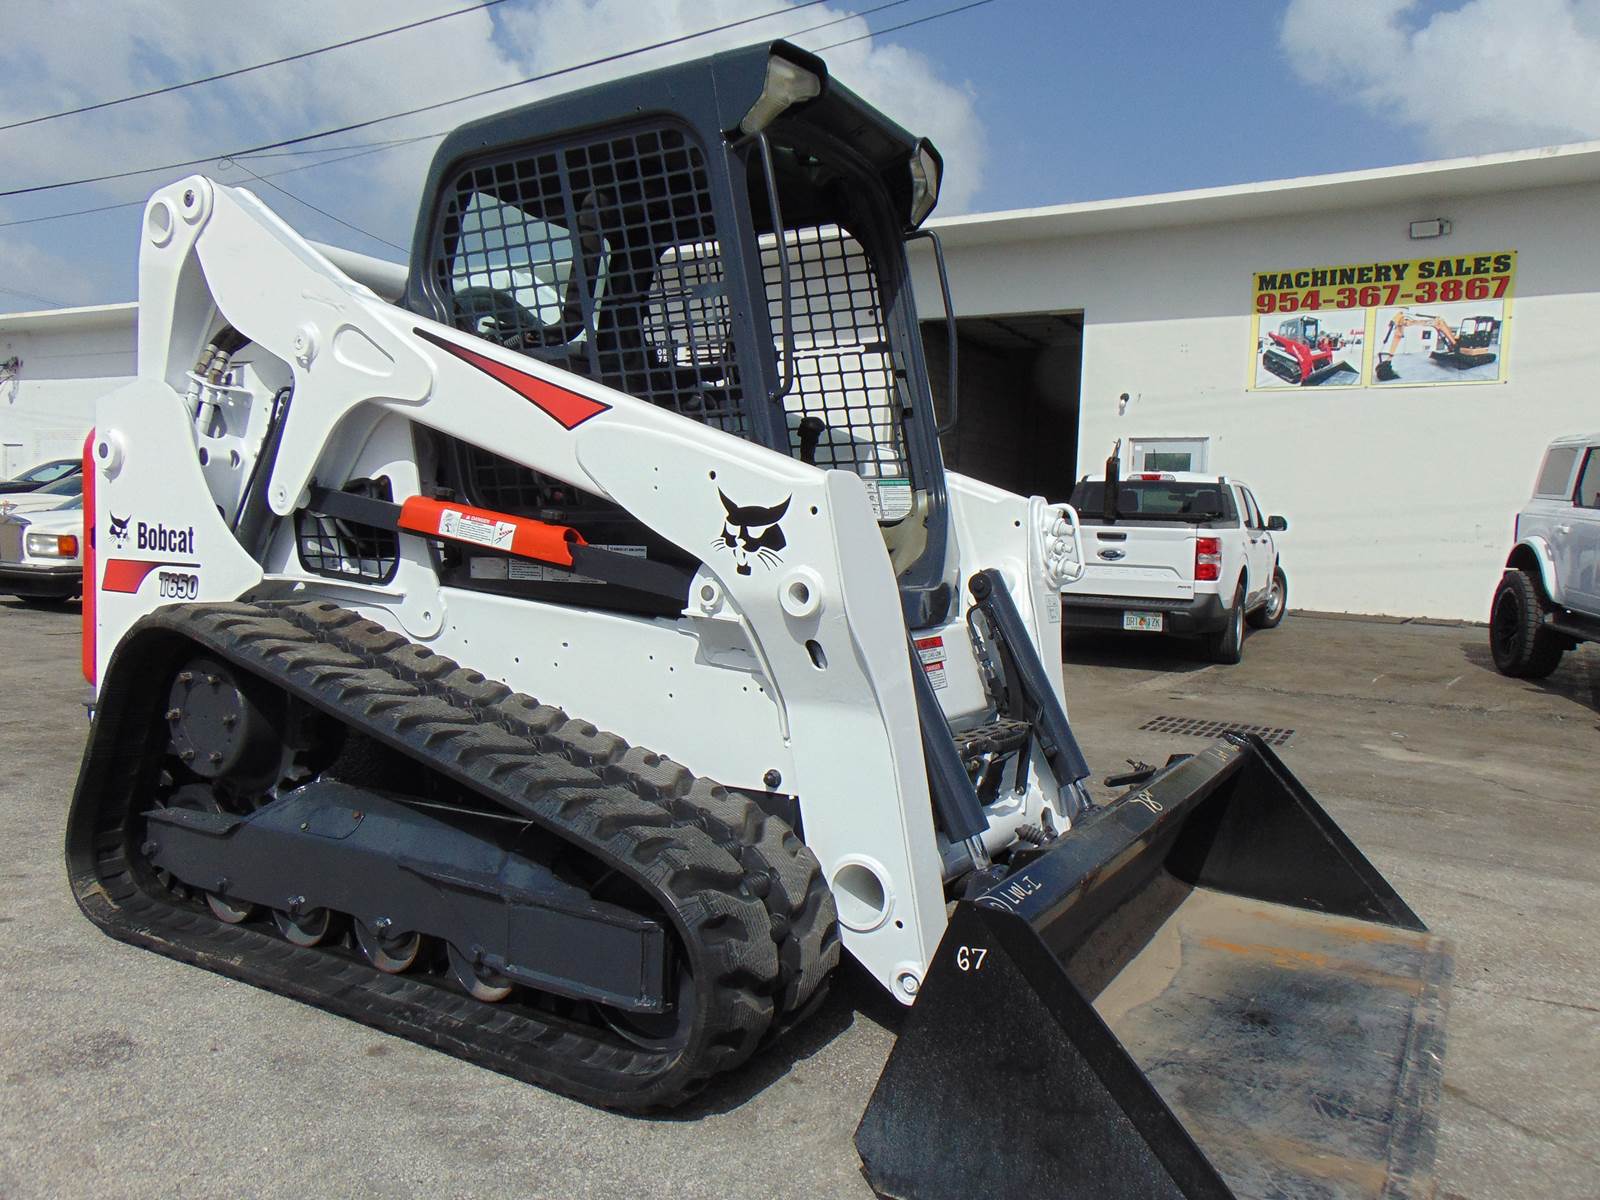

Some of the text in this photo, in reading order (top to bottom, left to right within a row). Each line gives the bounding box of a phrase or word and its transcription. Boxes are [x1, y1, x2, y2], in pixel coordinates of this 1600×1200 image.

[1258, 254, 1512, 291] MACHINERY SALES
[1256, 275, 1511, 314] 954-367-3867
[137, 522, 194, 554] Bobcat
[159, 571, 199, 600] T650
[957, 945, 987, 971] 67
